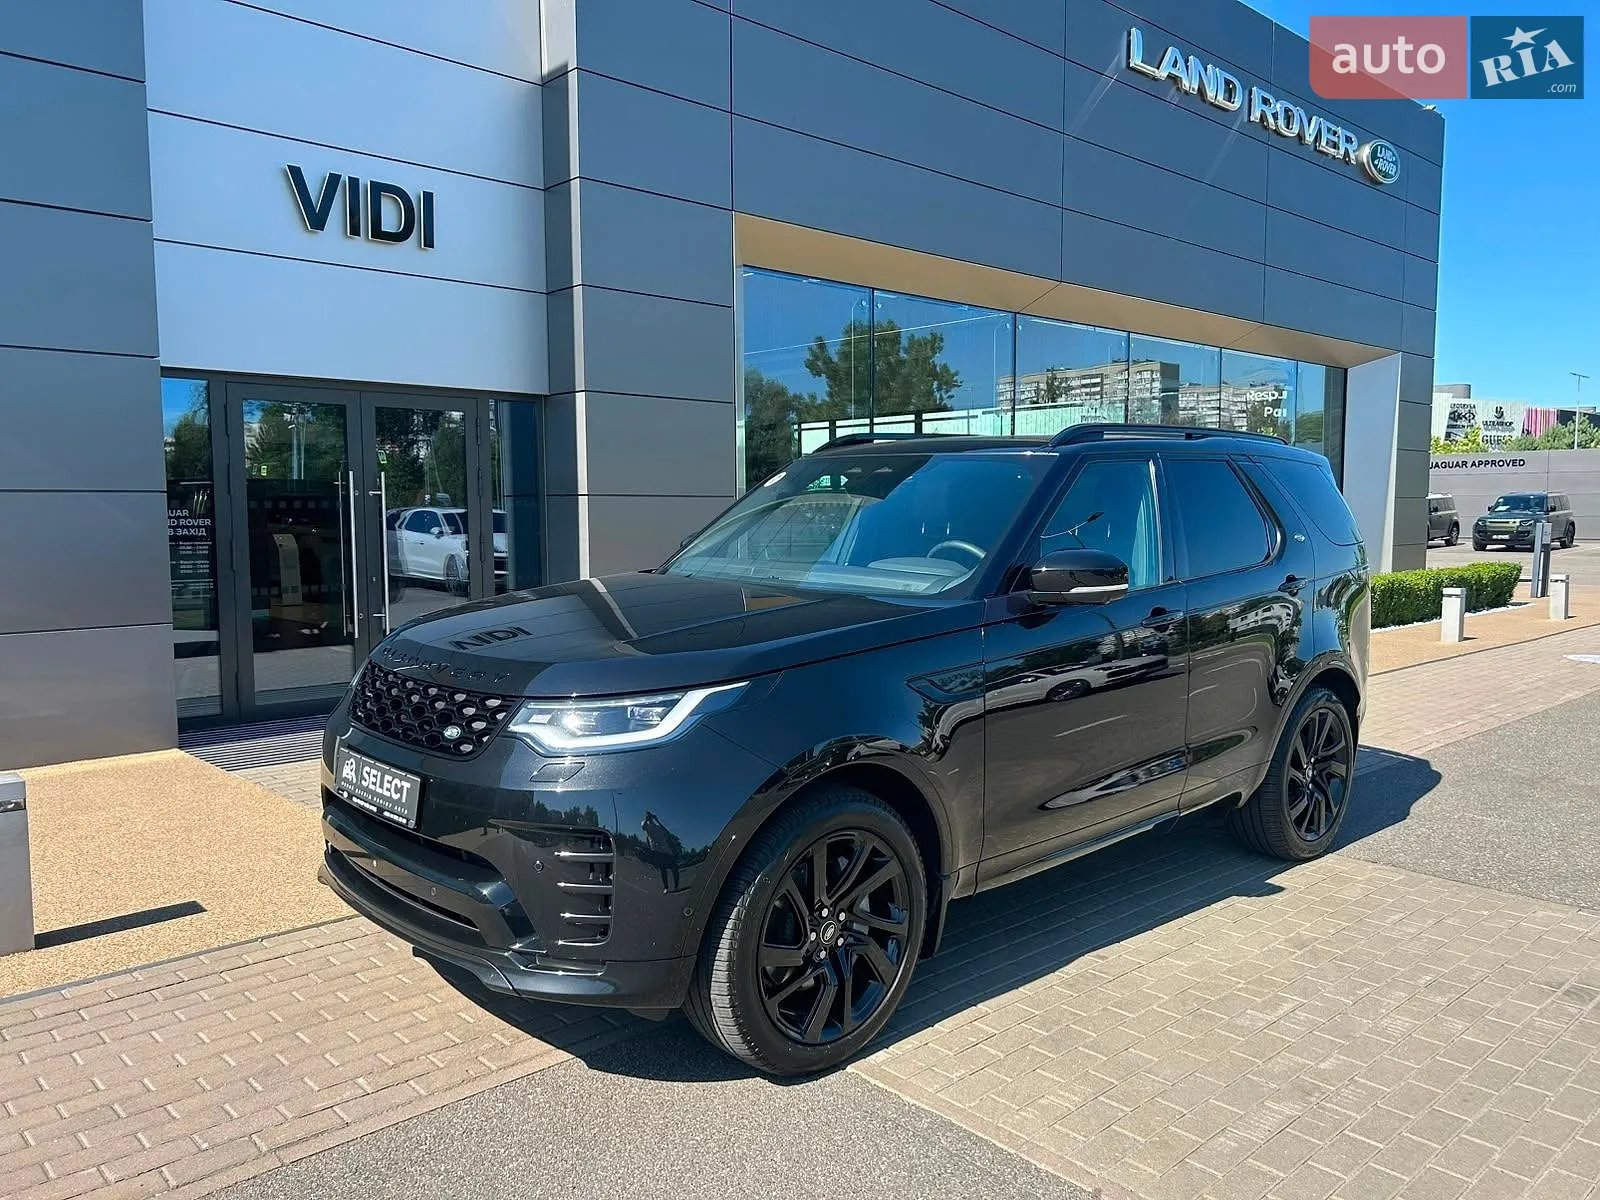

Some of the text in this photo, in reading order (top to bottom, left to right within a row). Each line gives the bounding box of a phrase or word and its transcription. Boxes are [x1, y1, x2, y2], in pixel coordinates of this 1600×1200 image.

[1128, 27, 1359, 165] LAND ROVER
[286, 163, 435, 250] VIDI
[1430, 459, 1525, 469] JAGUAR APPROVED
[179, 518, 212, 526] ROVER
[361, 765, 411, 803] SELECT
